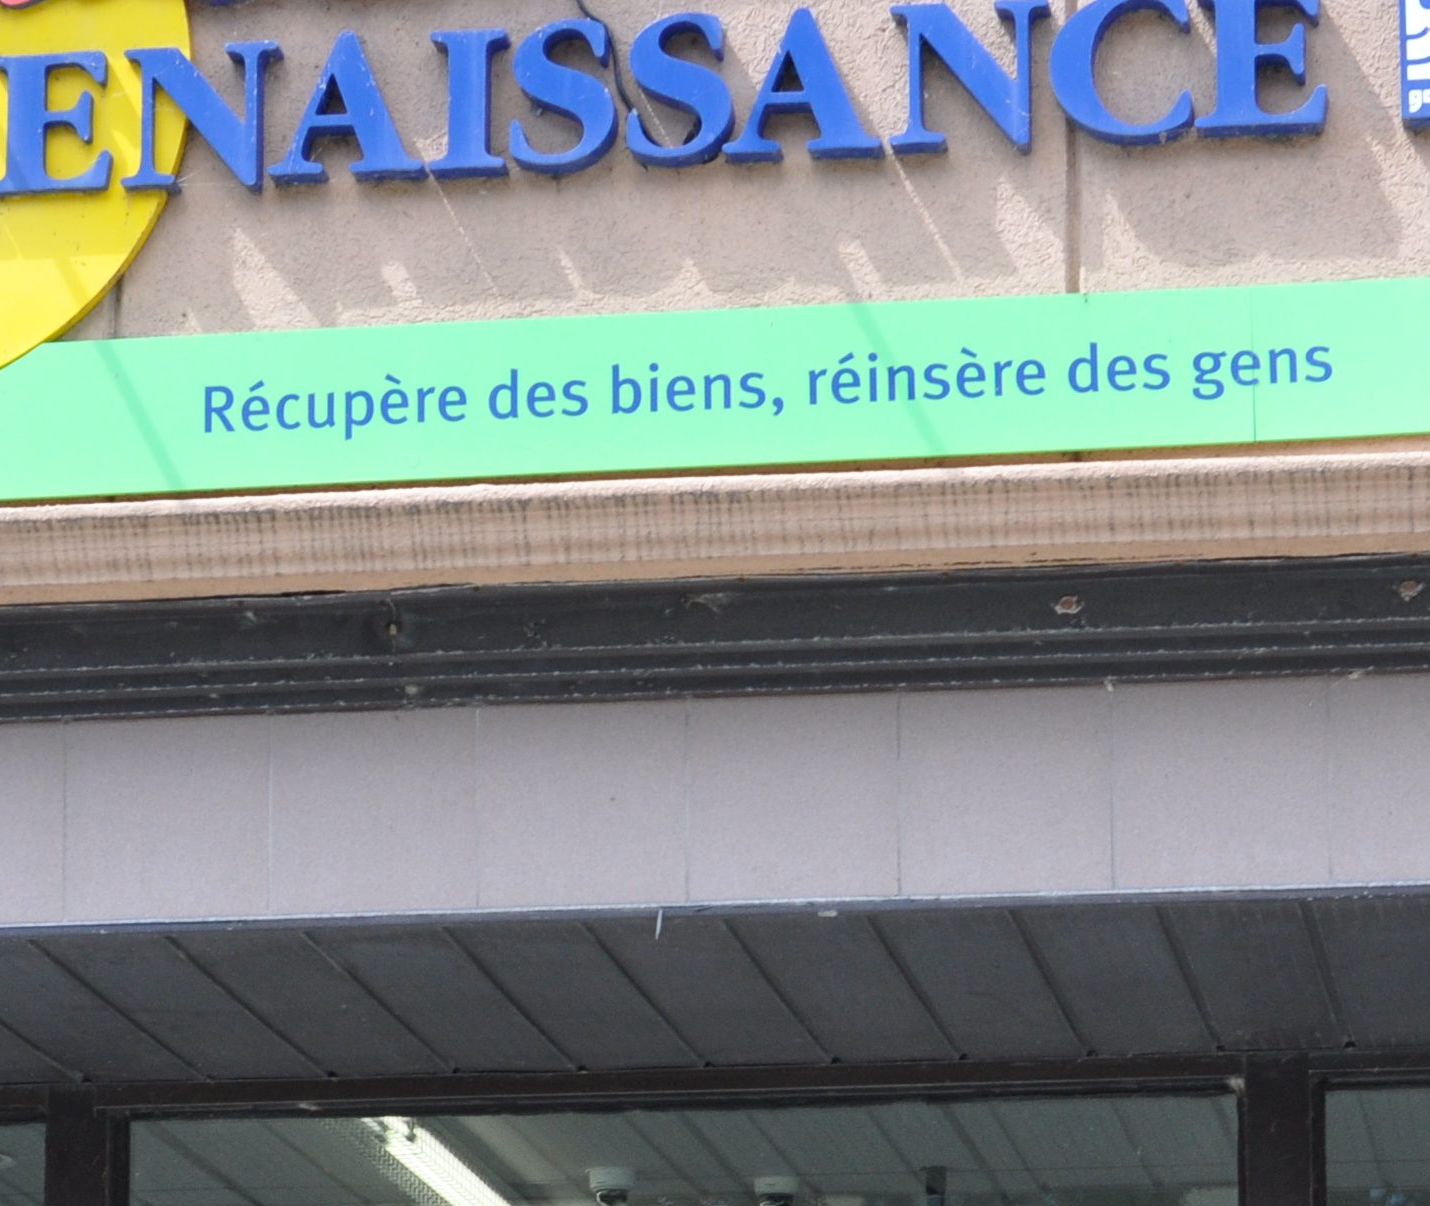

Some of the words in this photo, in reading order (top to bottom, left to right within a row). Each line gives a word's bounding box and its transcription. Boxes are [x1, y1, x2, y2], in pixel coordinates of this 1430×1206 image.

[204, 374, 468, 441] Récupère
[488, 368, 589, 420] des
[611, 362, 784, 417] biens,
[807, 348, 1046, 406] réinsère
[1069, 342, 1171, 393] des
[1191, 343, 1333, 400] gens
